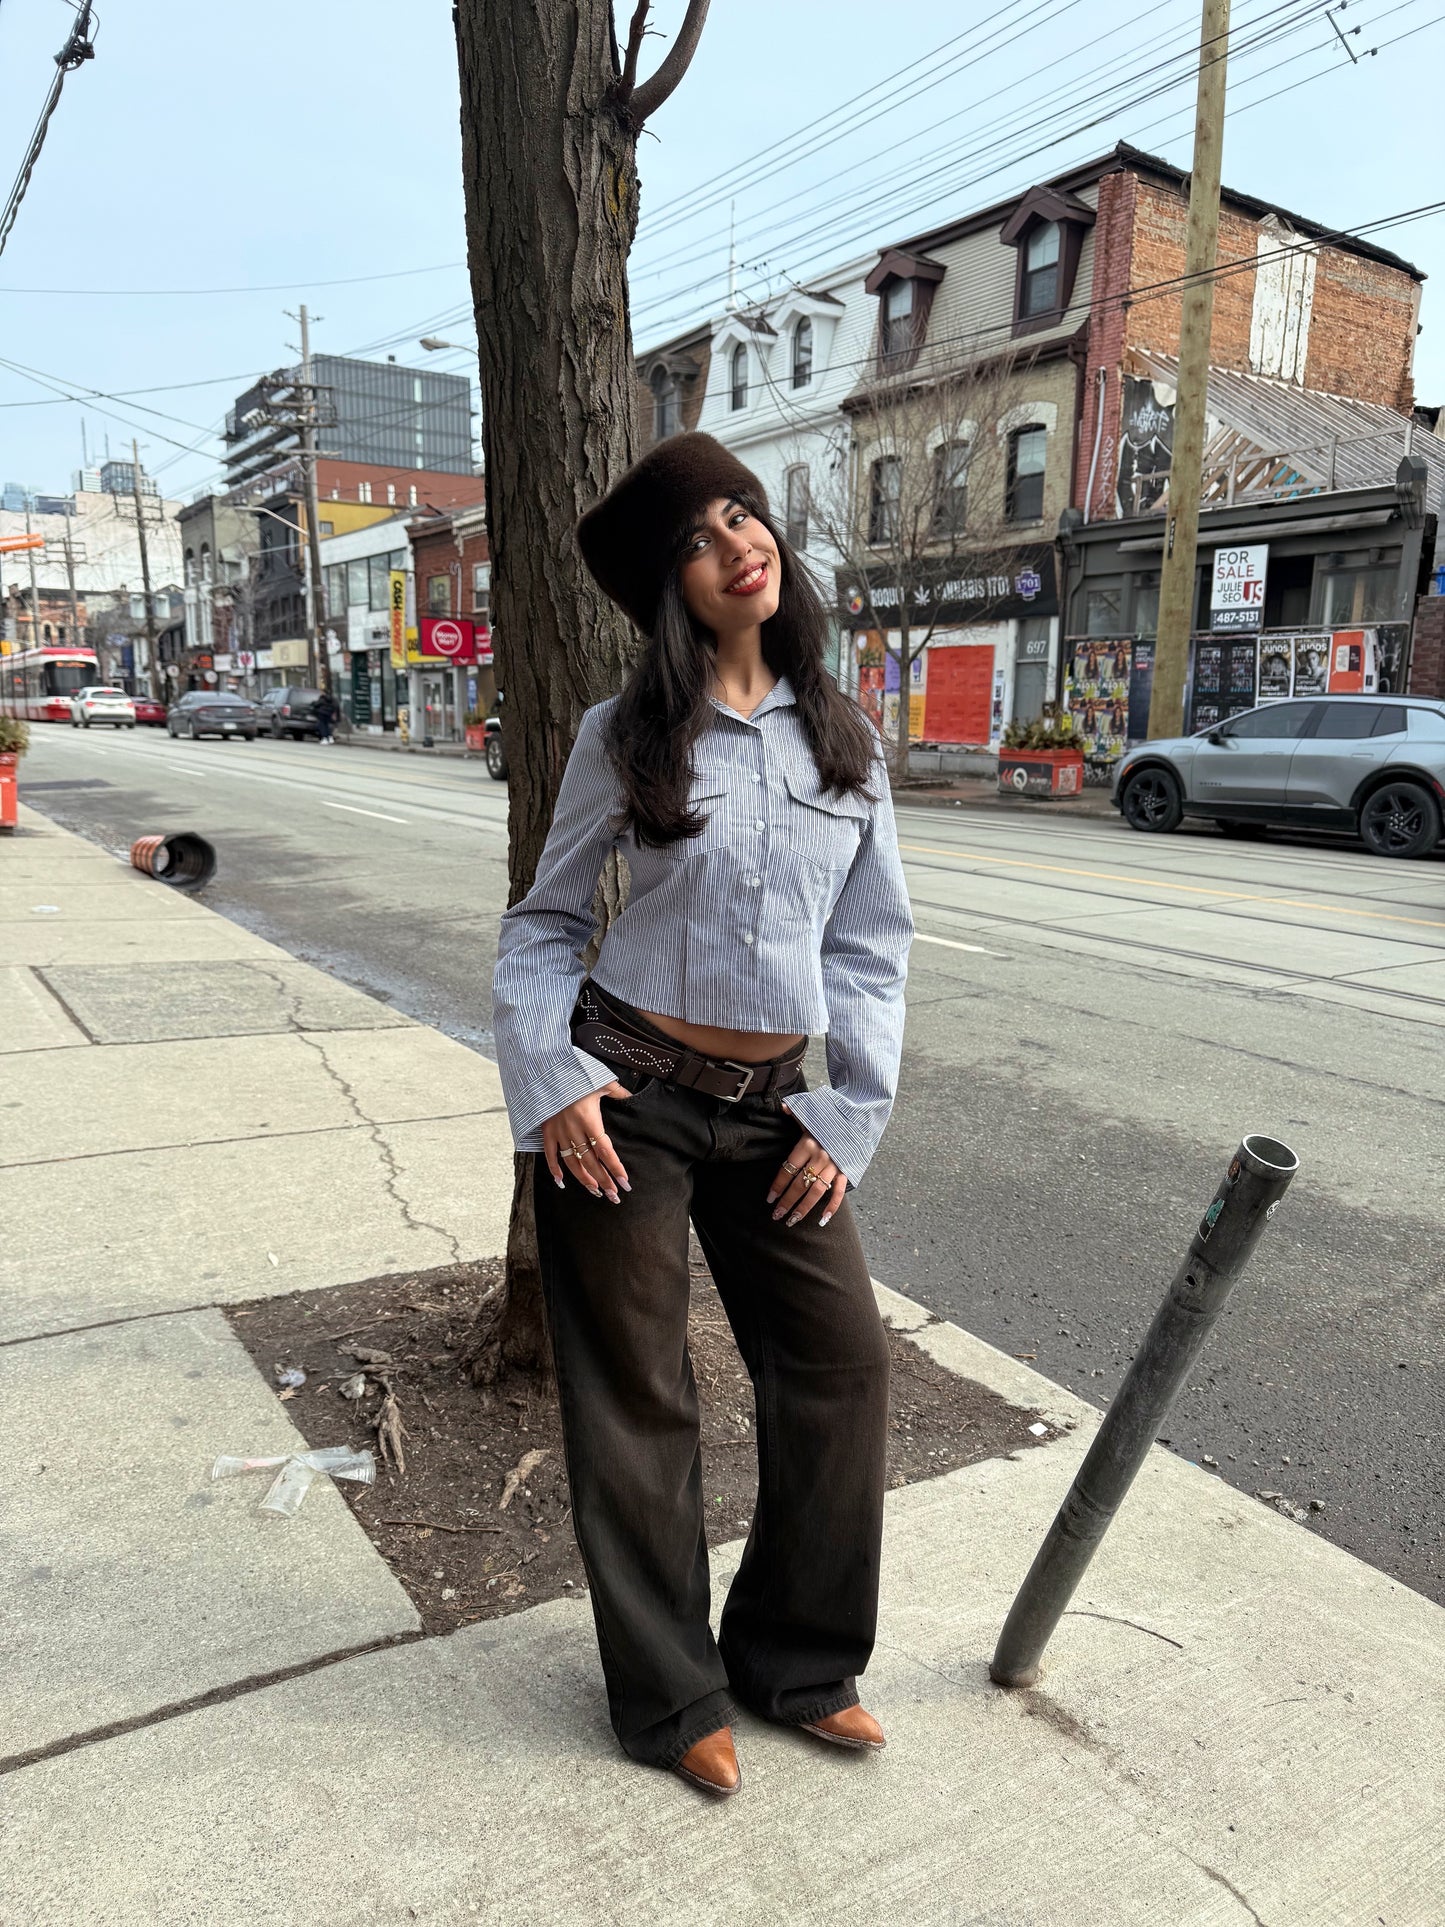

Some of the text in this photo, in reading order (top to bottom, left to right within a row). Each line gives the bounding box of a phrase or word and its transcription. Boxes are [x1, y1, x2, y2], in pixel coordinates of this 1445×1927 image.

[1218, 551, 1249, 565] FOR
[1217, 565, 1255, 579] SALE
[934, 578, 985, 602] CANNABIS
[986, 576, 1010, 598] 1701
[1017, 578, 1038, 590] 1701
[1217, 581, 1242, 593] JULIE
[393, 580, 403, 610] CASH
[1222, 592, 1242, 603] SEO
[1216, 611, 1259, 623] 487-5131
[1026, 641, 1046, 655] 697
